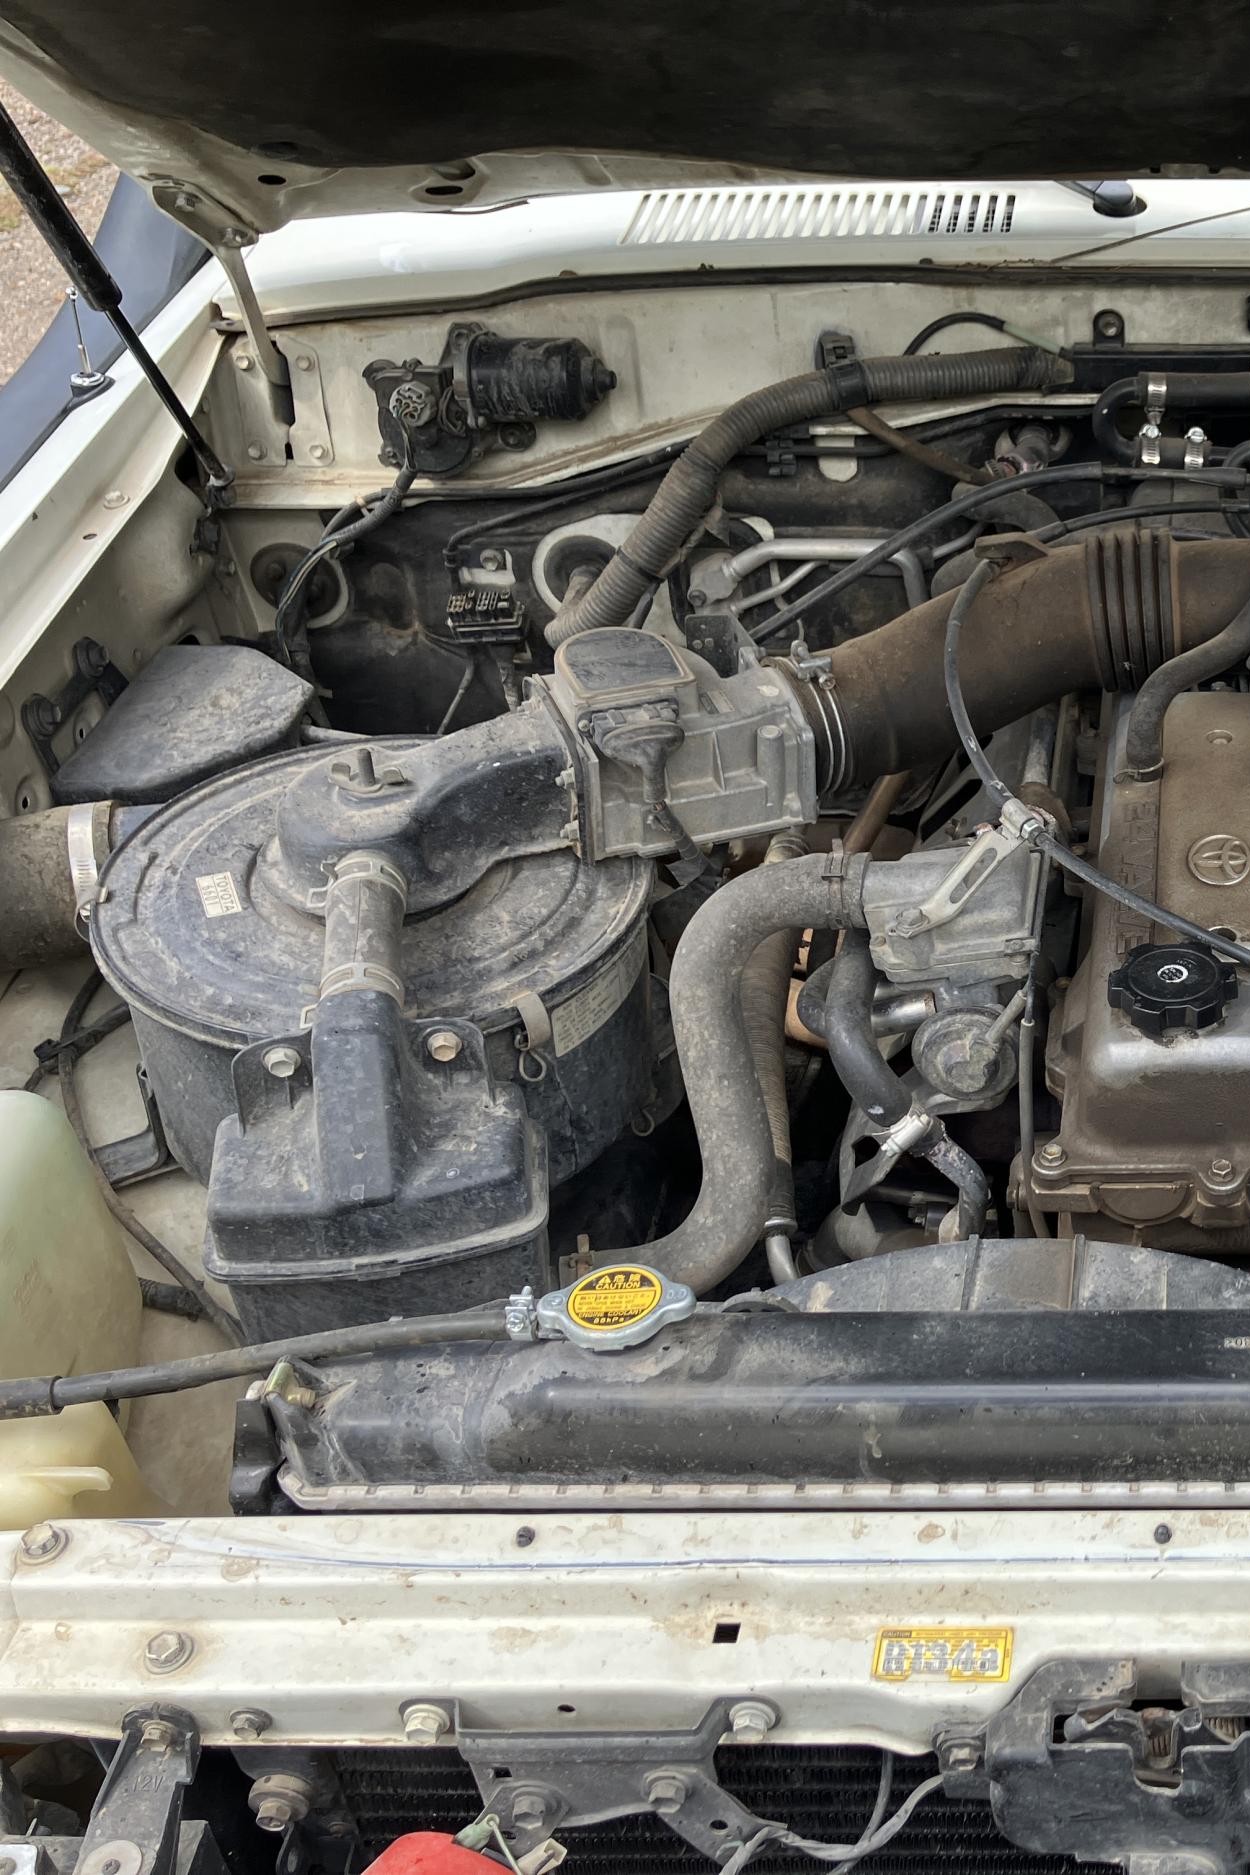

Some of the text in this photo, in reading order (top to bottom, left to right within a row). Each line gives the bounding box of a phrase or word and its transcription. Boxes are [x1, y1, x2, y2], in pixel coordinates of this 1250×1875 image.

[216, 875, 235, 912] TOYOTA
[595, 1281, 640, 1290] CAUTION
[883, 1639, 999, 1673] R134a
